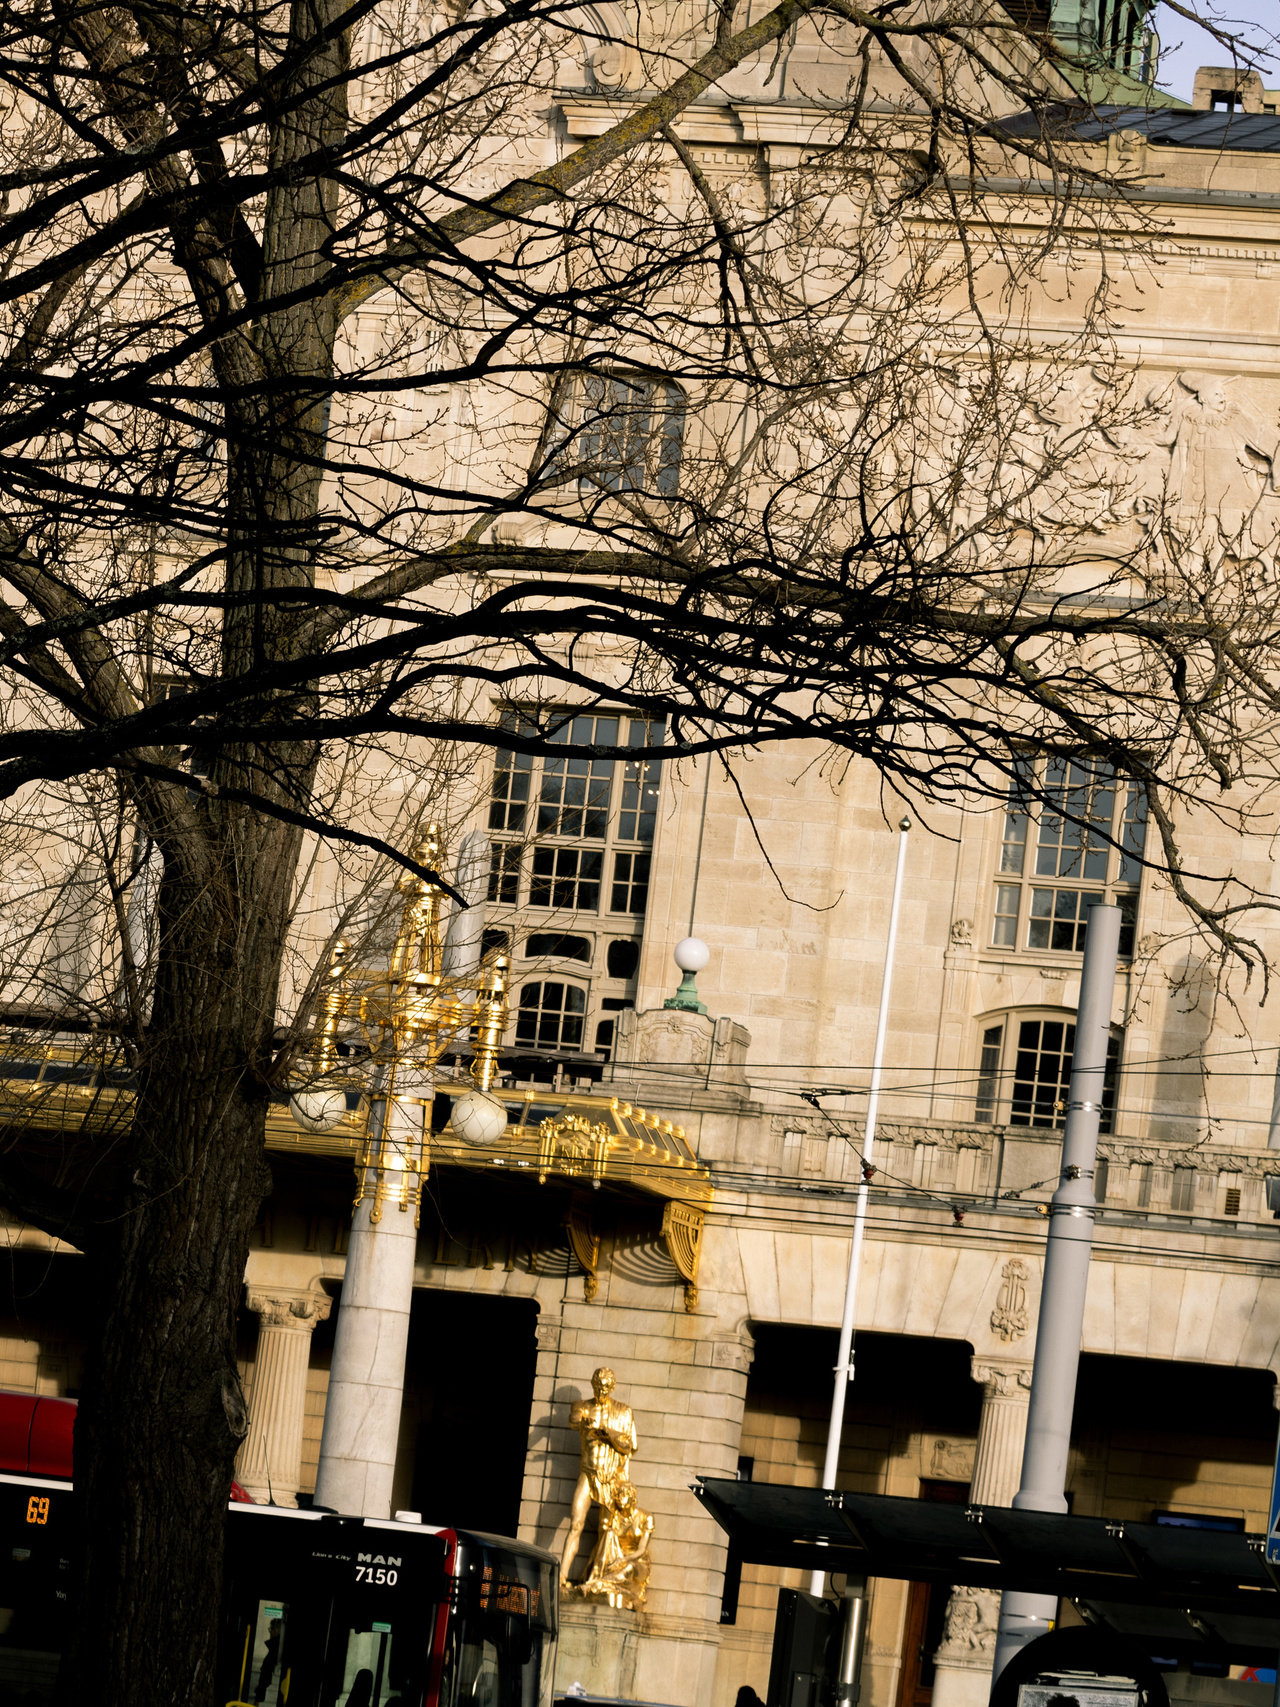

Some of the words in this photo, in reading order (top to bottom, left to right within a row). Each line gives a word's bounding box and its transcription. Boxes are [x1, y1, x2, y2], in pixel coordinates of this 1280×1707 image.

[26, 1496, 50, 1525] 69
[357, 1552, 402, 1567] MAN
[355, 1566, 398, 1586] 7150
